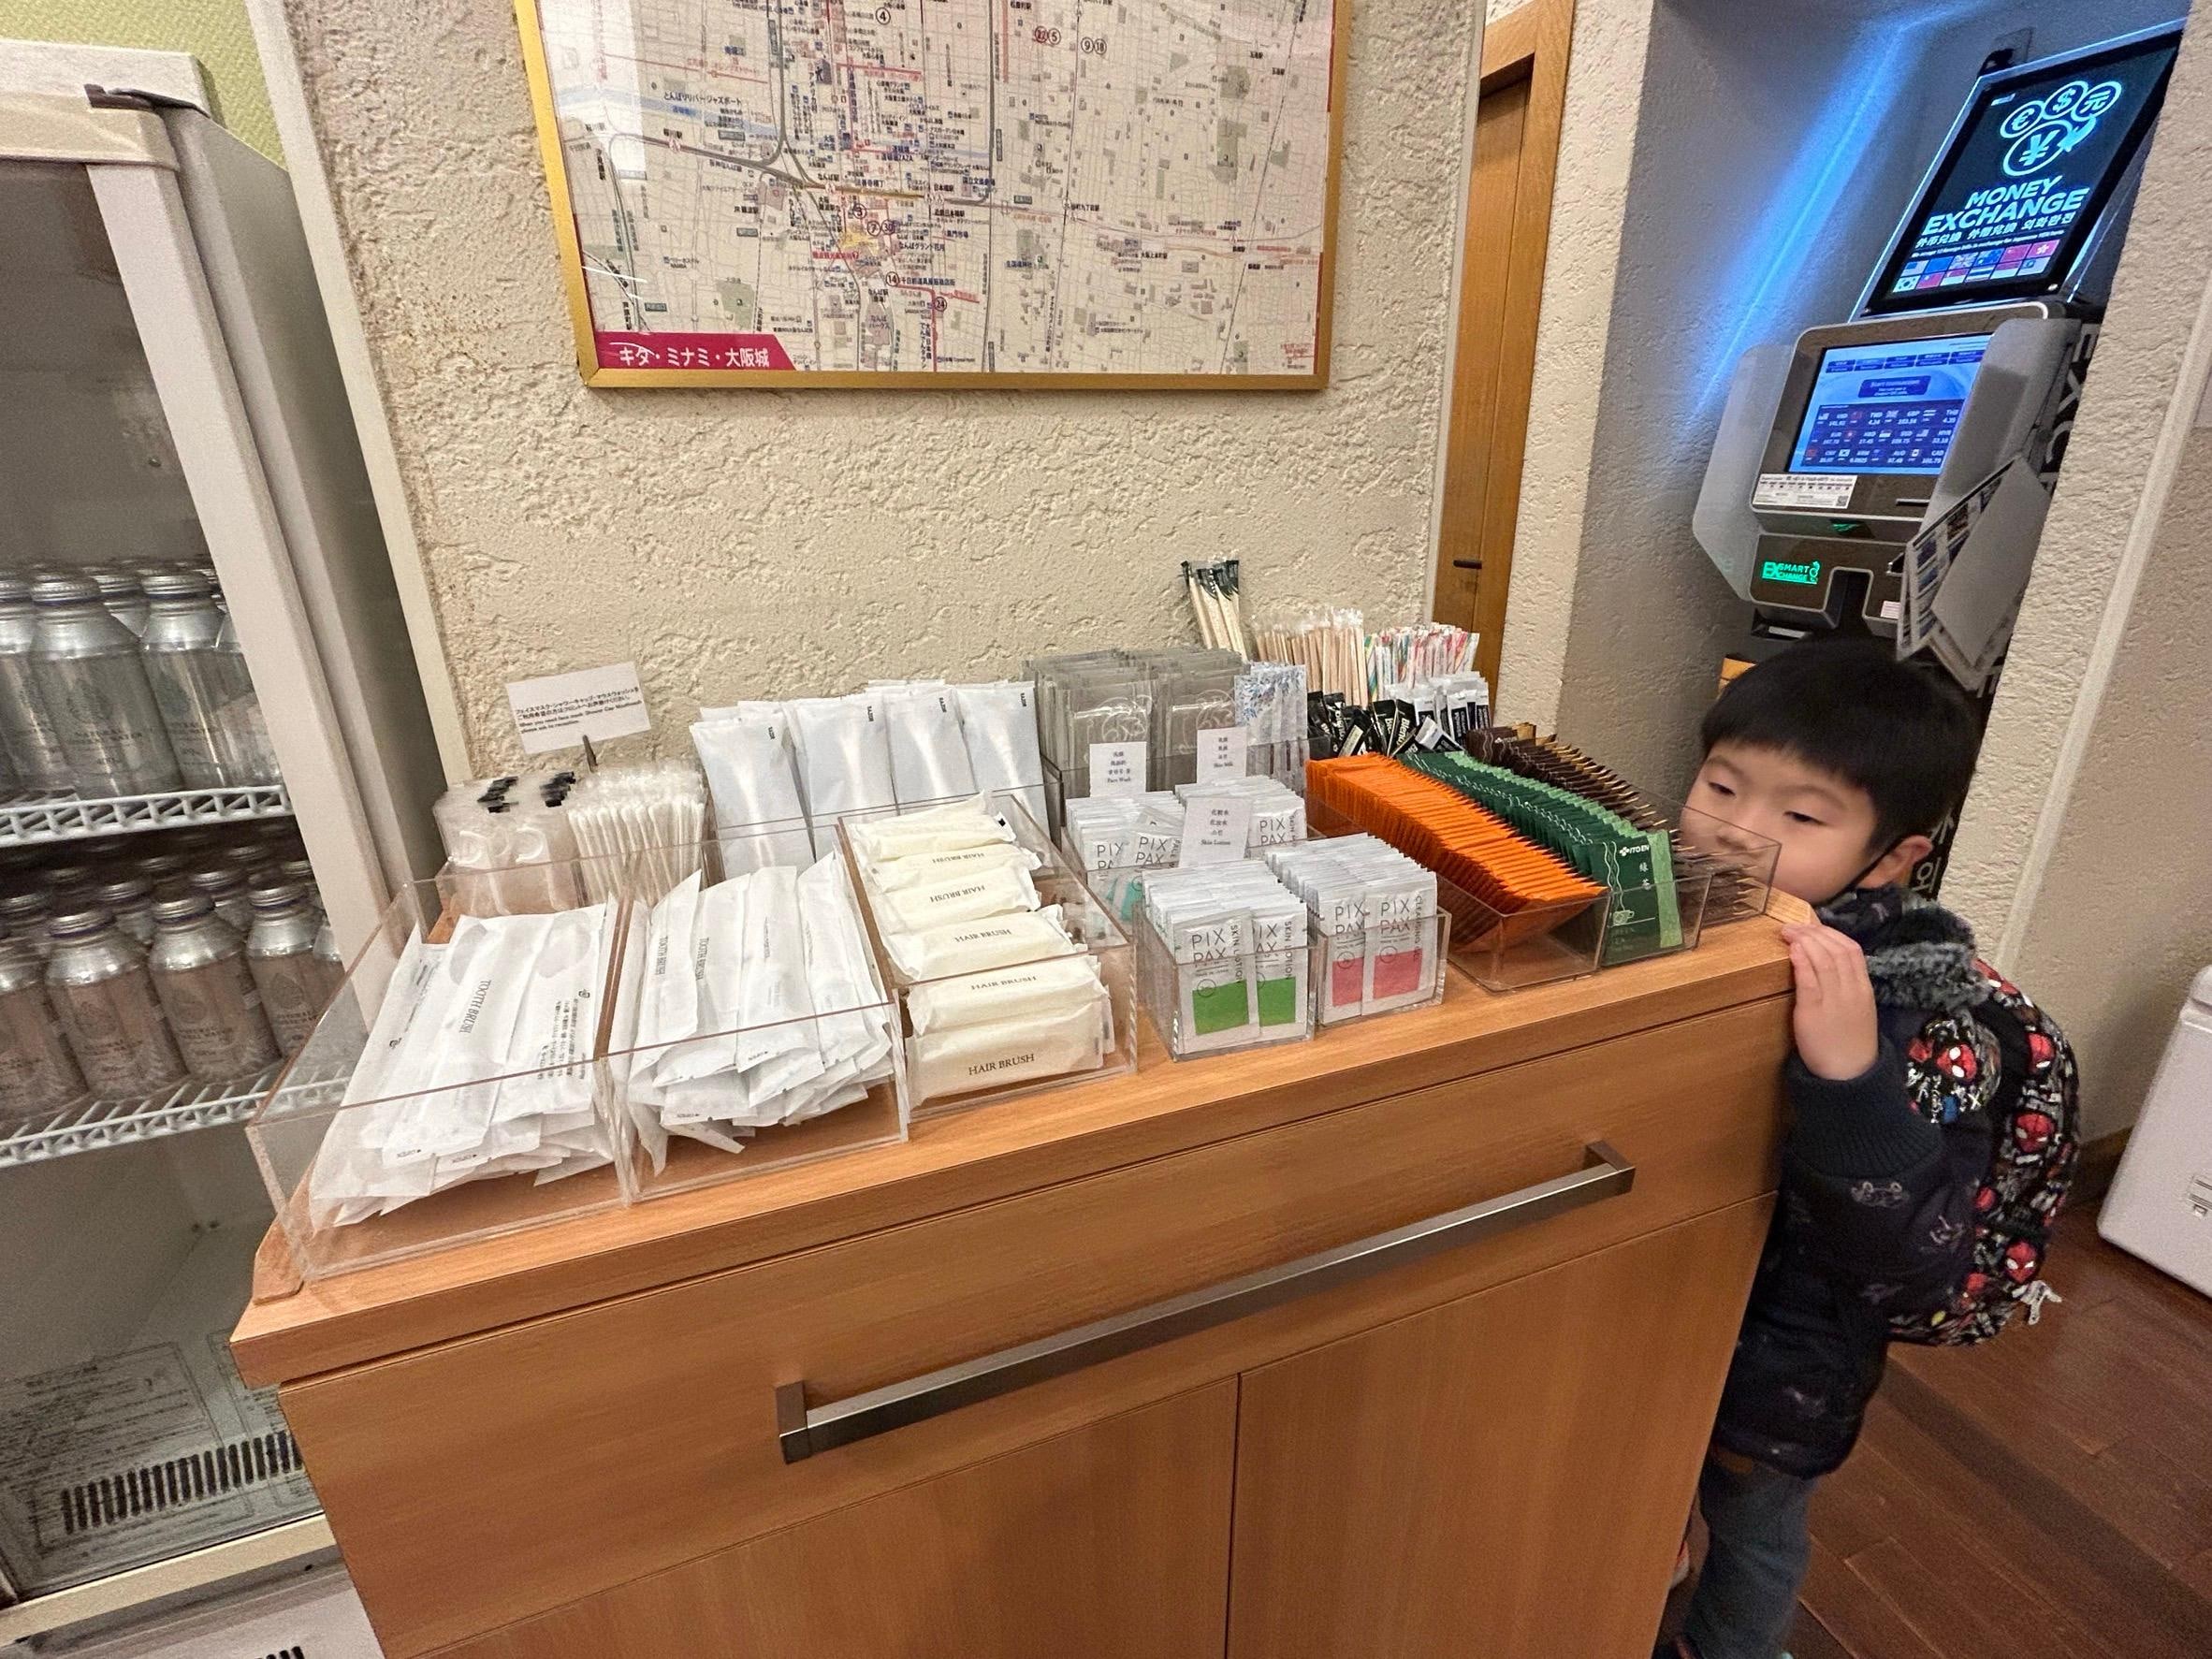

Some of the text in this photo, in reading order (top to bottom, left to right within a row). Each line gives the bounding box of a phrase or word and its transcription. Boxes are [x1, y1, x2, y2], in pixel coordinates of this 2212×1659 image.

[1965, 175, 2063, 209] MONEY
[1921, 187, 2090, 236] EXCHANGE
[620, 347, 770, 368] キタ・ミナミ・大阪城
[1777, 563, 1810, 574] SMART
[1259, 817, 1286, 833] PIX
[1139, 837, 1168, 851] PIX
[1260, 833, 1286, 846] PAX
[1135, 851, 1165, 866] PAX
[929, 885, 985, 903] HAIR BRUSH
[1335, 899, 1365, 921] PIX
[1381, 898, 1410, 916] PIX
[1230, 924, 1240, 945] SKIN
[1253, 924, 1278, 939] IX
[1380, 917, 1410, 934] PAX
[953, 929, 1012, 943] HAIR BRUSH
[1192, 928, 1226, 949] PIX
[1193, 948, 1227, 966] PAX
[971, 976, 1038, 990] HAIR BRUSH
[458, 980, 491, 1033] TOOTH BRUSH
[968, 1054, 1035, 1076] HAIR BRUSH
